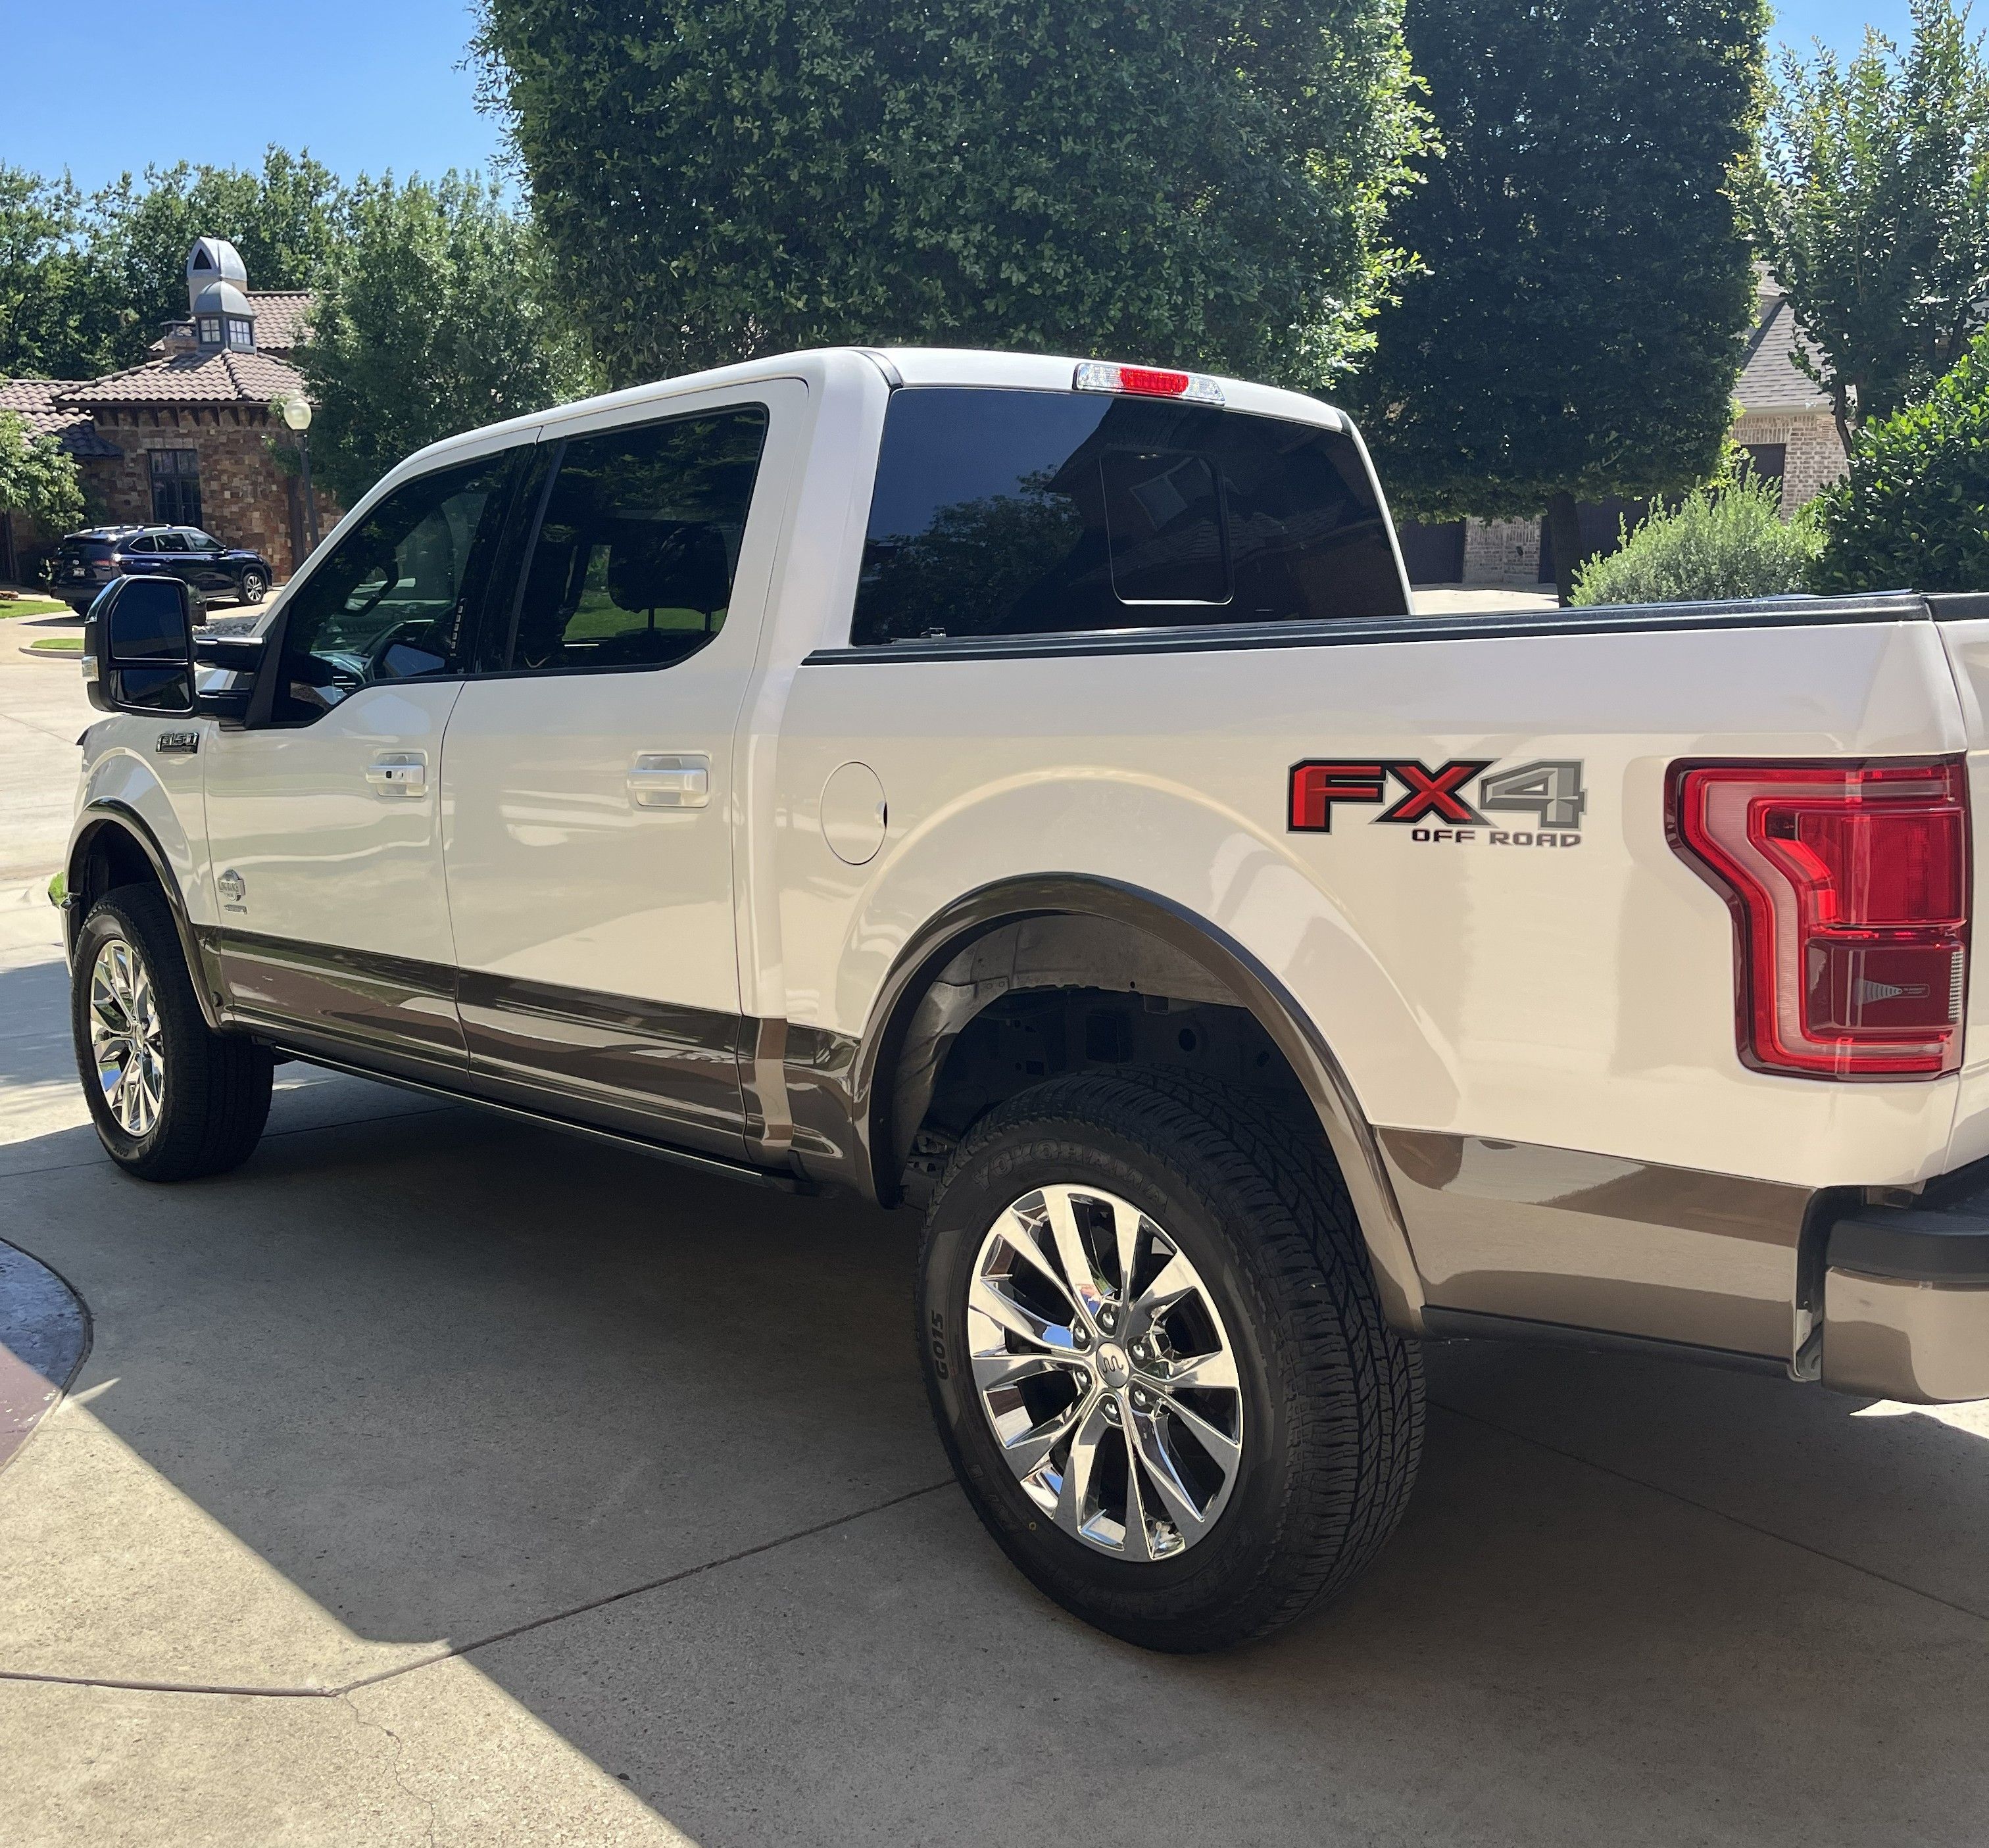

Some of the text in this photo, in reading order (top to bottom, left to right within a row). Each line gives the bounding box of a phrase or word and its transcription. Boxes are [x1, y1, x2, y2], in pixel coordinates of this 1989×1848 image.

[1287, 758, 1588, 834] FX4
[1412, 829, 1581, 847] OFF ROAD
[974, 1139, 1169, 1213] YOKOHAMA
[932, 1309, 948, 1380] GO15
